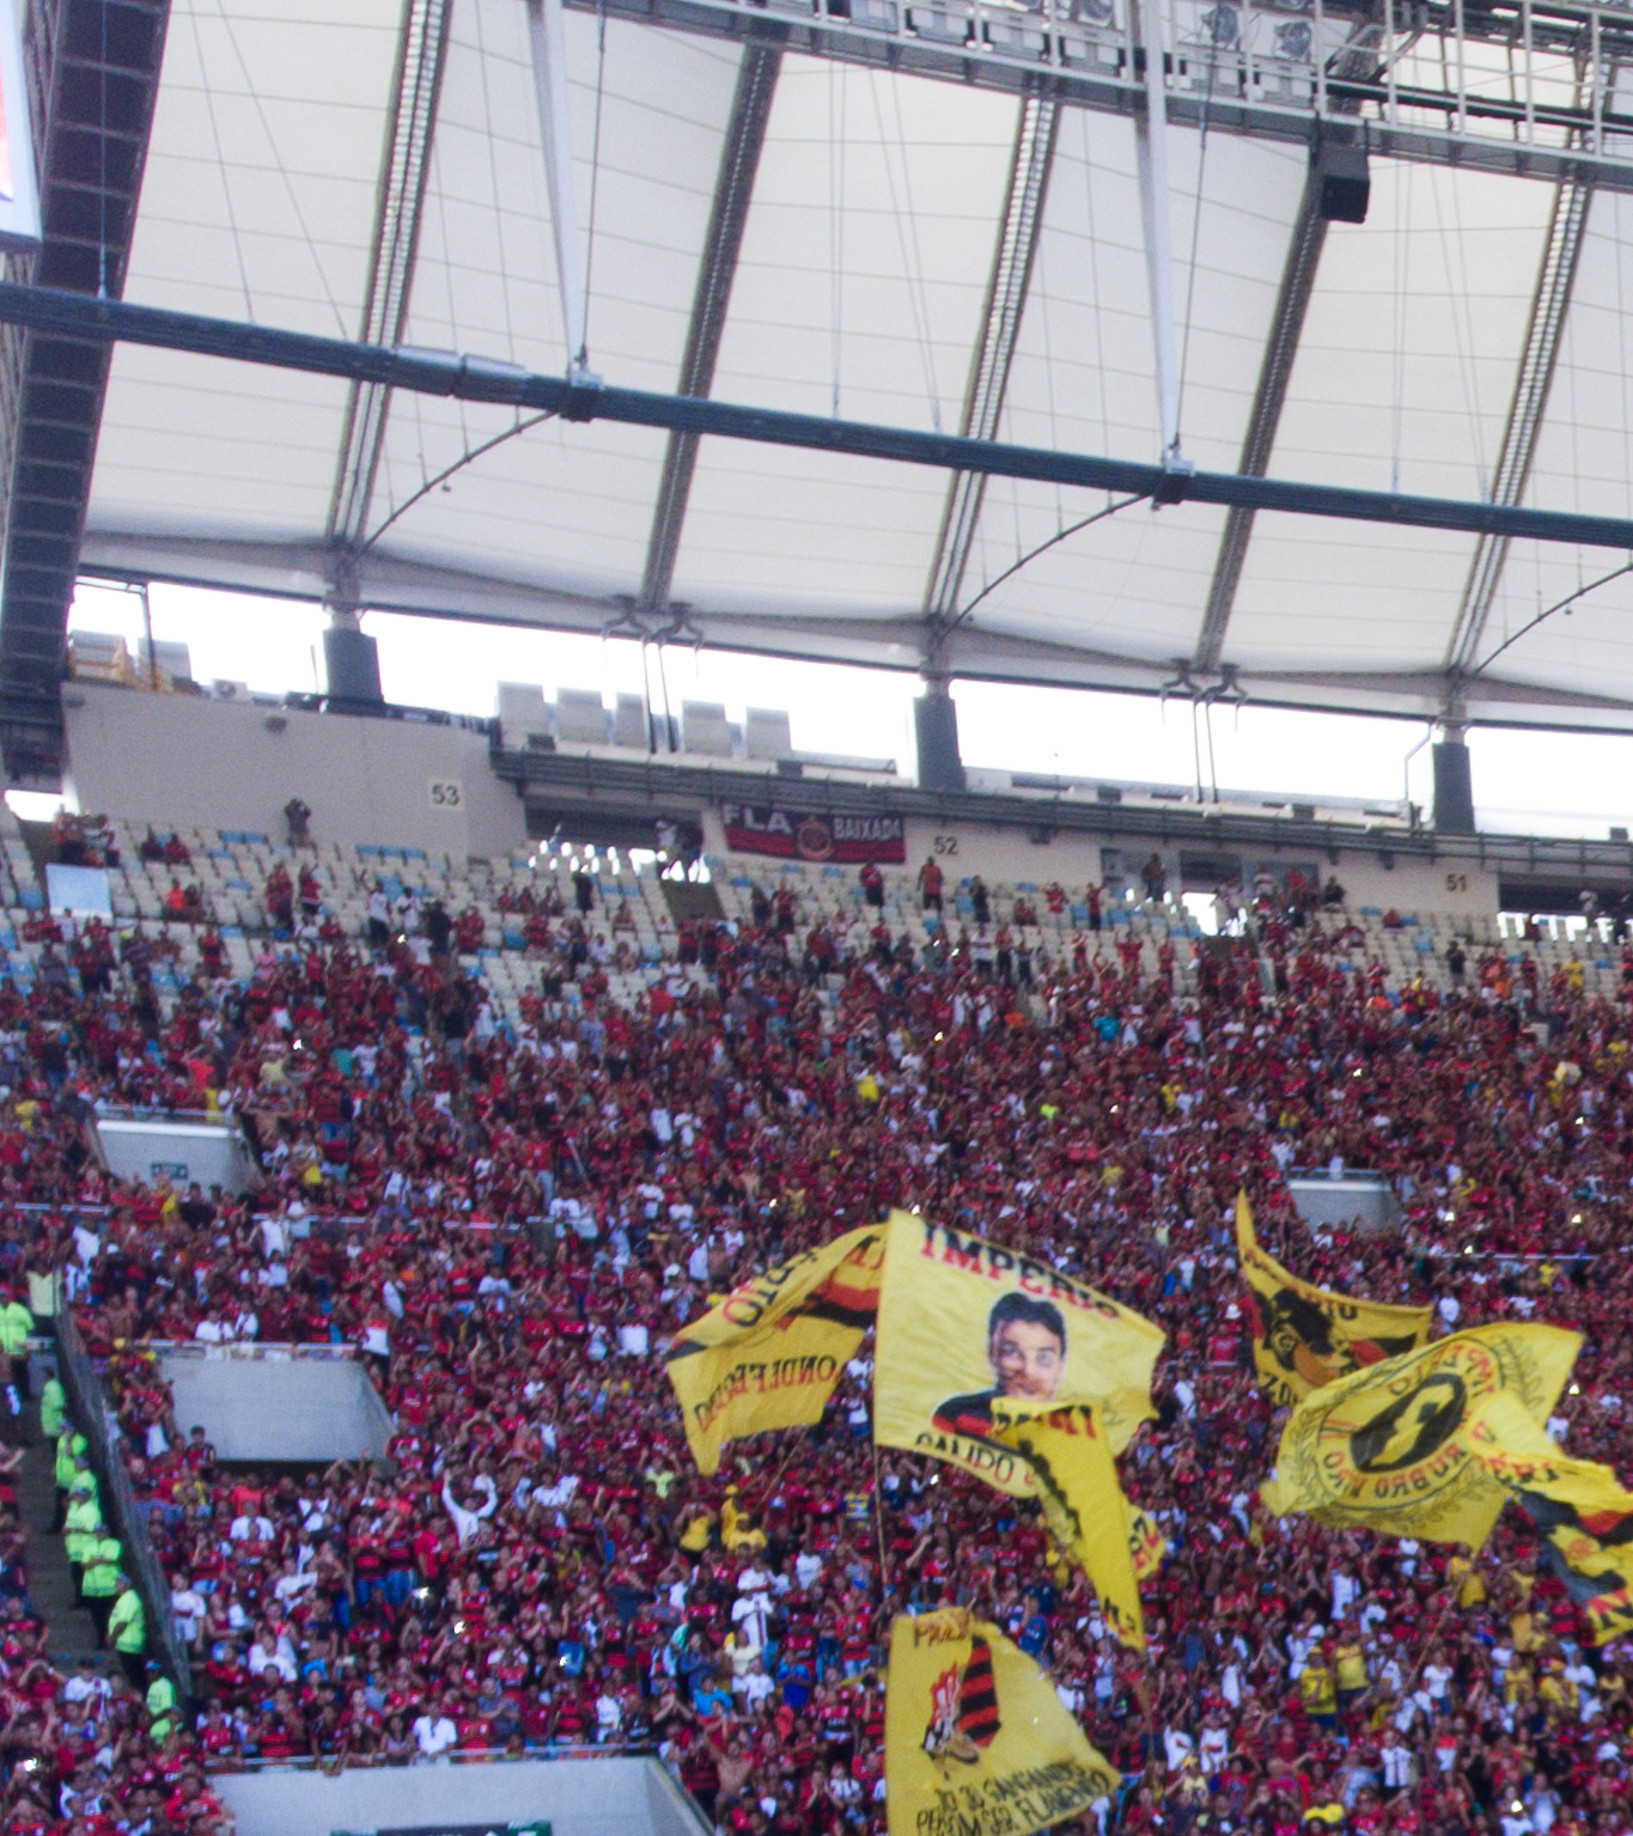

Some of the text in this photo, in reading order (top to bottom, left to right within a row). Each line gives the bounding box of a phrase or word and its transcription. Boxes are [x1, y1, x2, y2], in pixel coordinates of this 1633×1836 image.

[432, 784, 460, 804] 53
[723, 804, 792, 834] FLA
[933, 835, 958, 855] 52
[1446, 873, 1467, 891] 51
